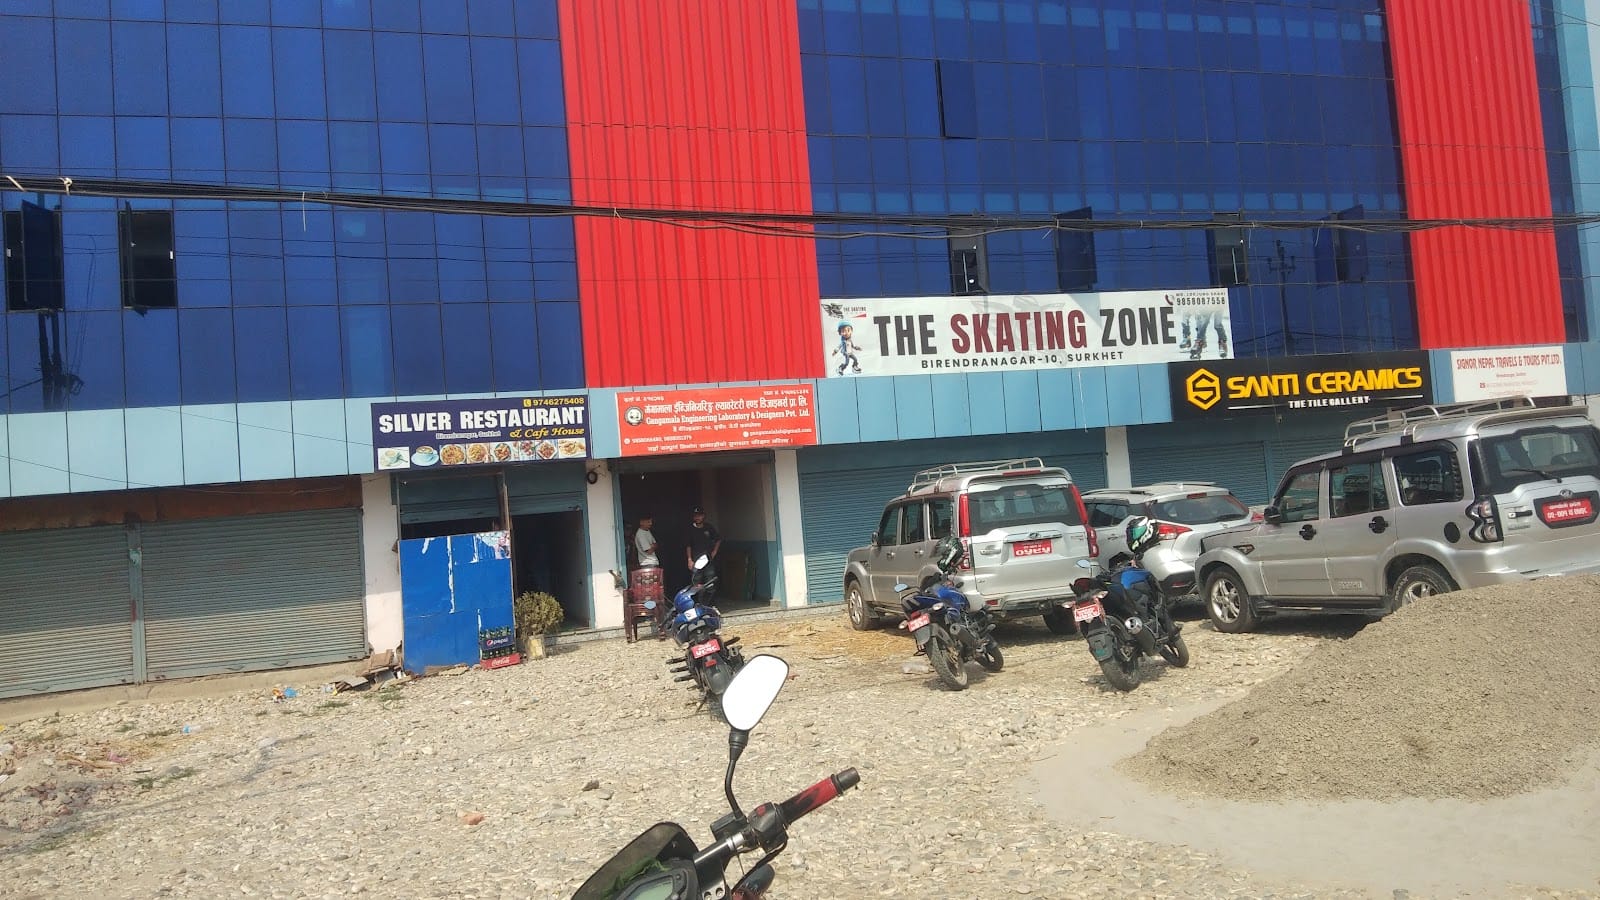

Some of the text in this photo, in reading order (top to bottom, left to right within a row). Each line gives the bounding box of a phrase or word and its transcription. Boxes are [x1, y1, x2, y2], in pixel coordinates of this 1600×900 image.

[873, 306, 1177, 357] THE SKATING ZONE
[921, 351, 1124, 369] BIRENDRANAGAR-10, SURKHET
[1478, 357, 1495, 369] NEPAL
[1495, 356, 1518, 368] TRAVELS
[1523, 354, 1540, 367] TOURS
[1227, 367, 1422, 399] SANTI CERAMICS
[532, 397, 585, 407] 9746275408
[1288, 399, 1307, 409] THE
[1306, 398, 1330, 408] TILE
[378, 406, 585, 434] SILVER RESTAURANT
[646, 408, 810, 426] Gangamala Engineering Laboratory & Designers Pvt. Ltd.
[524, 428, 549, 439] Cafe
[551, 427, 585, 436] House
[493, 637, 509, 645] pepsi
